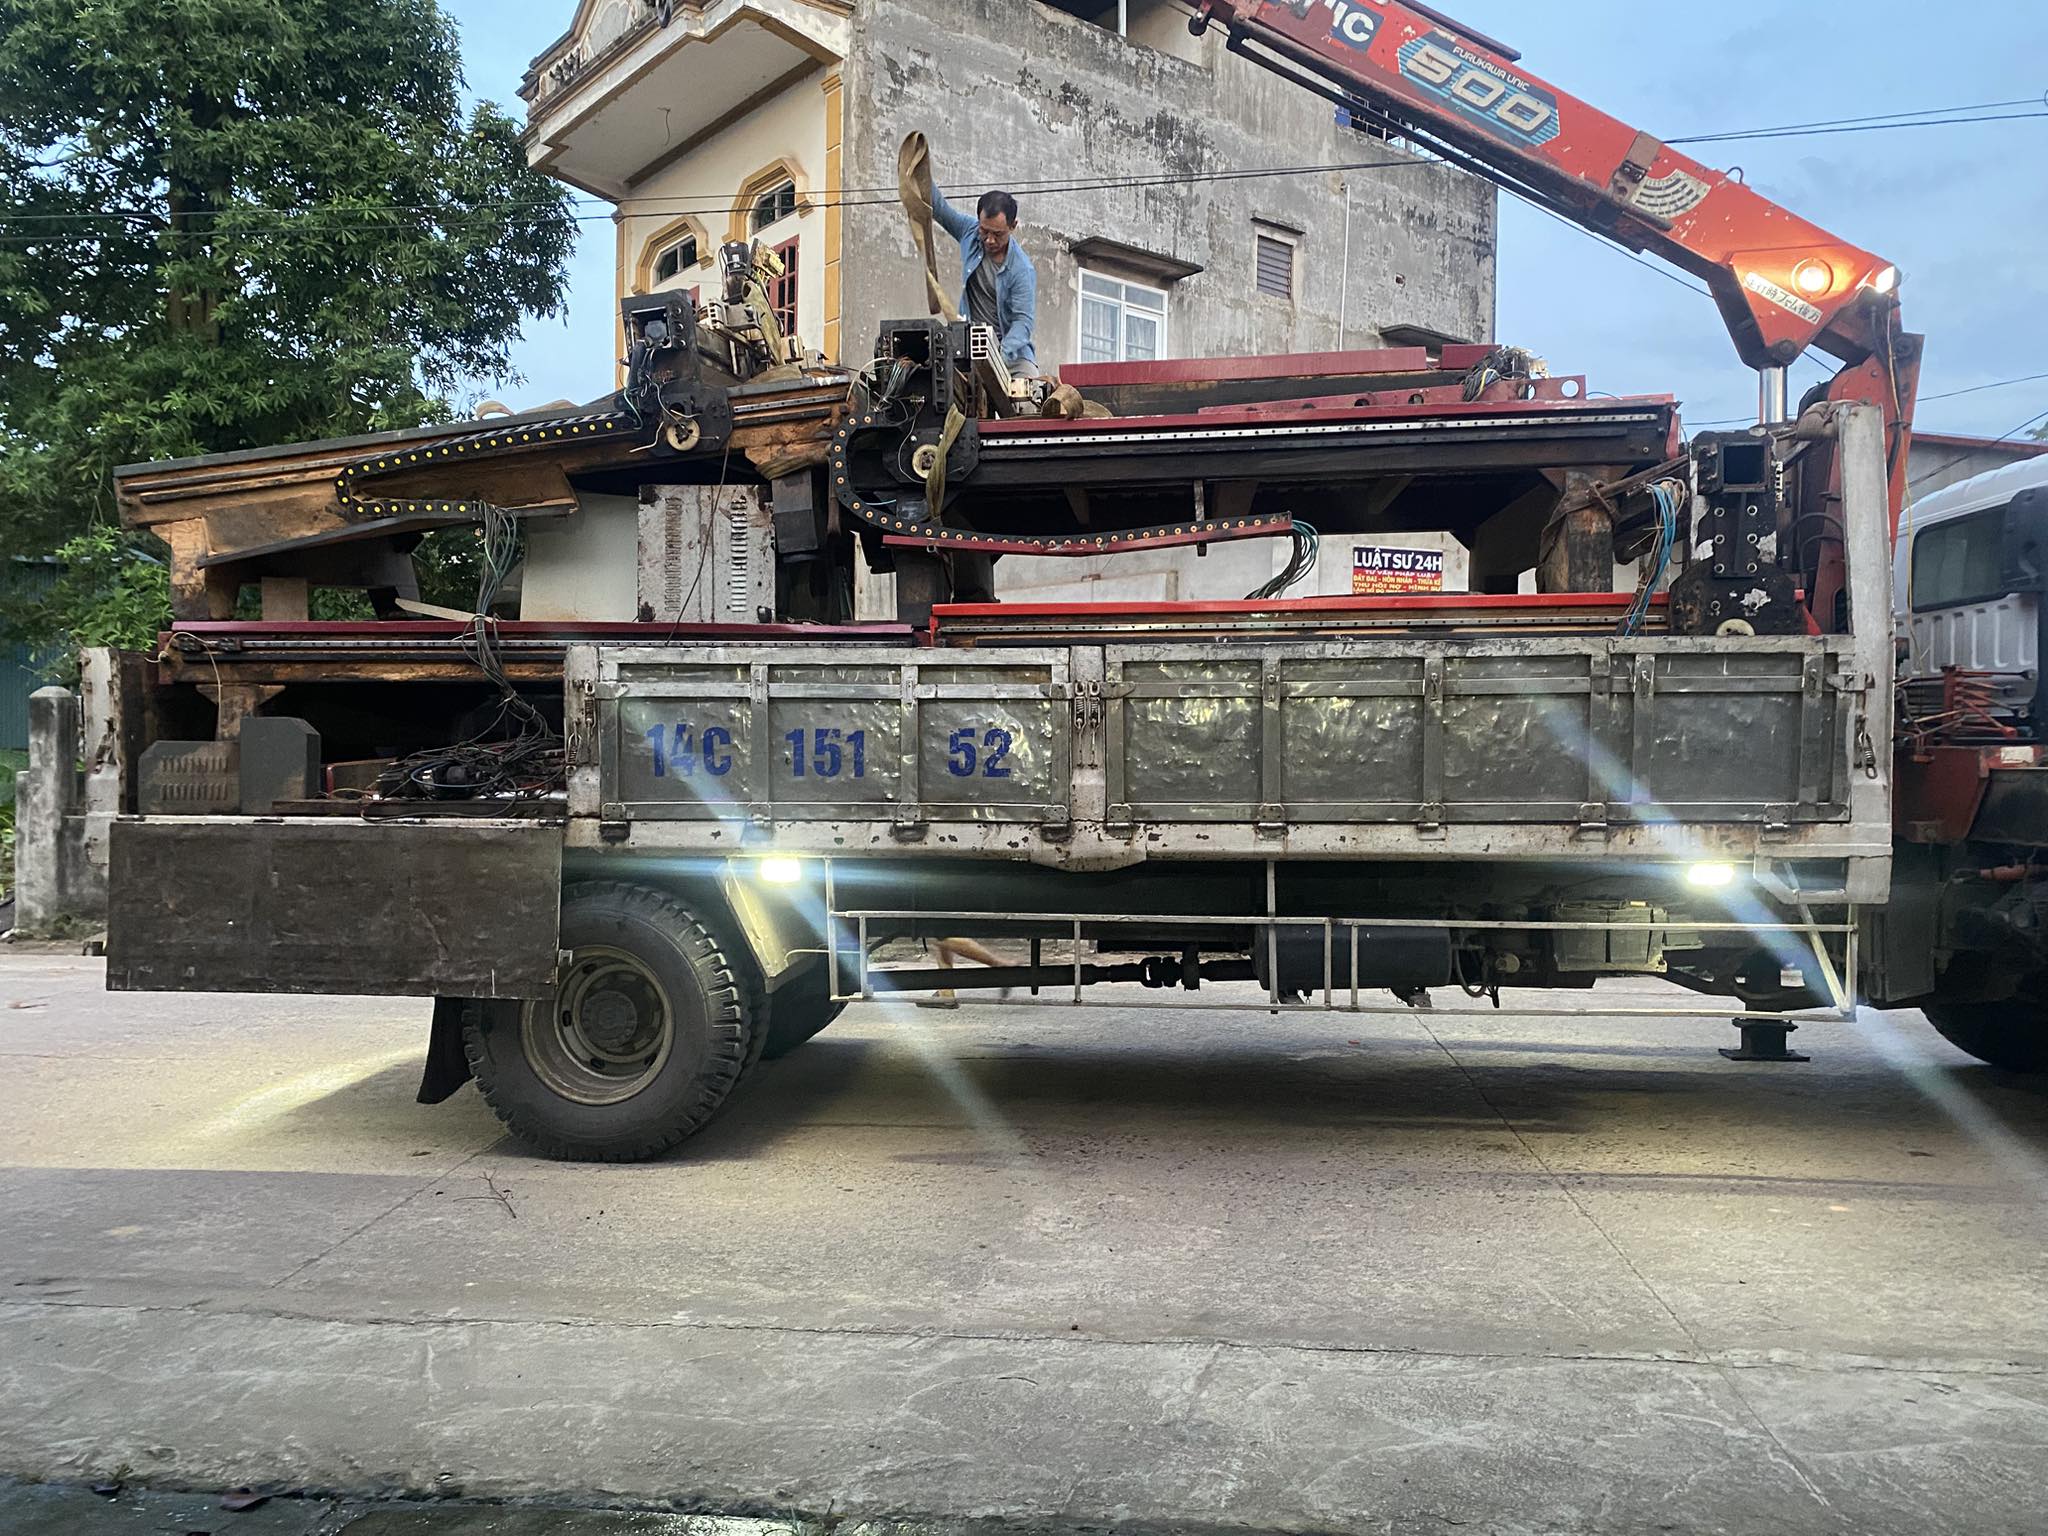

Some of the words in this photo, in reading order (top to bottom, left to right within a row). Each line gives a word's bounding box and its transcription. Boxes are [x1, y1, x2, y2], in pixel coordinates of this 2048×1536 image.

[1288, 0, 1374, 42] IC
[1405, 44, 1552, 133] 500
[1453, 46, 1506, 79] FURUKAWA
[1506, 74, 1530, 92] UNIC
[1354, 547, 1391, 570] LUẬT
[1392, 552, 1414, 570] SƯ
[1415, 556, 1442, 571] 24H
[647, 724, 731, 777] 14C
[785, 728, 865, 777] 151
[948, 728, 1012, 778] 52
